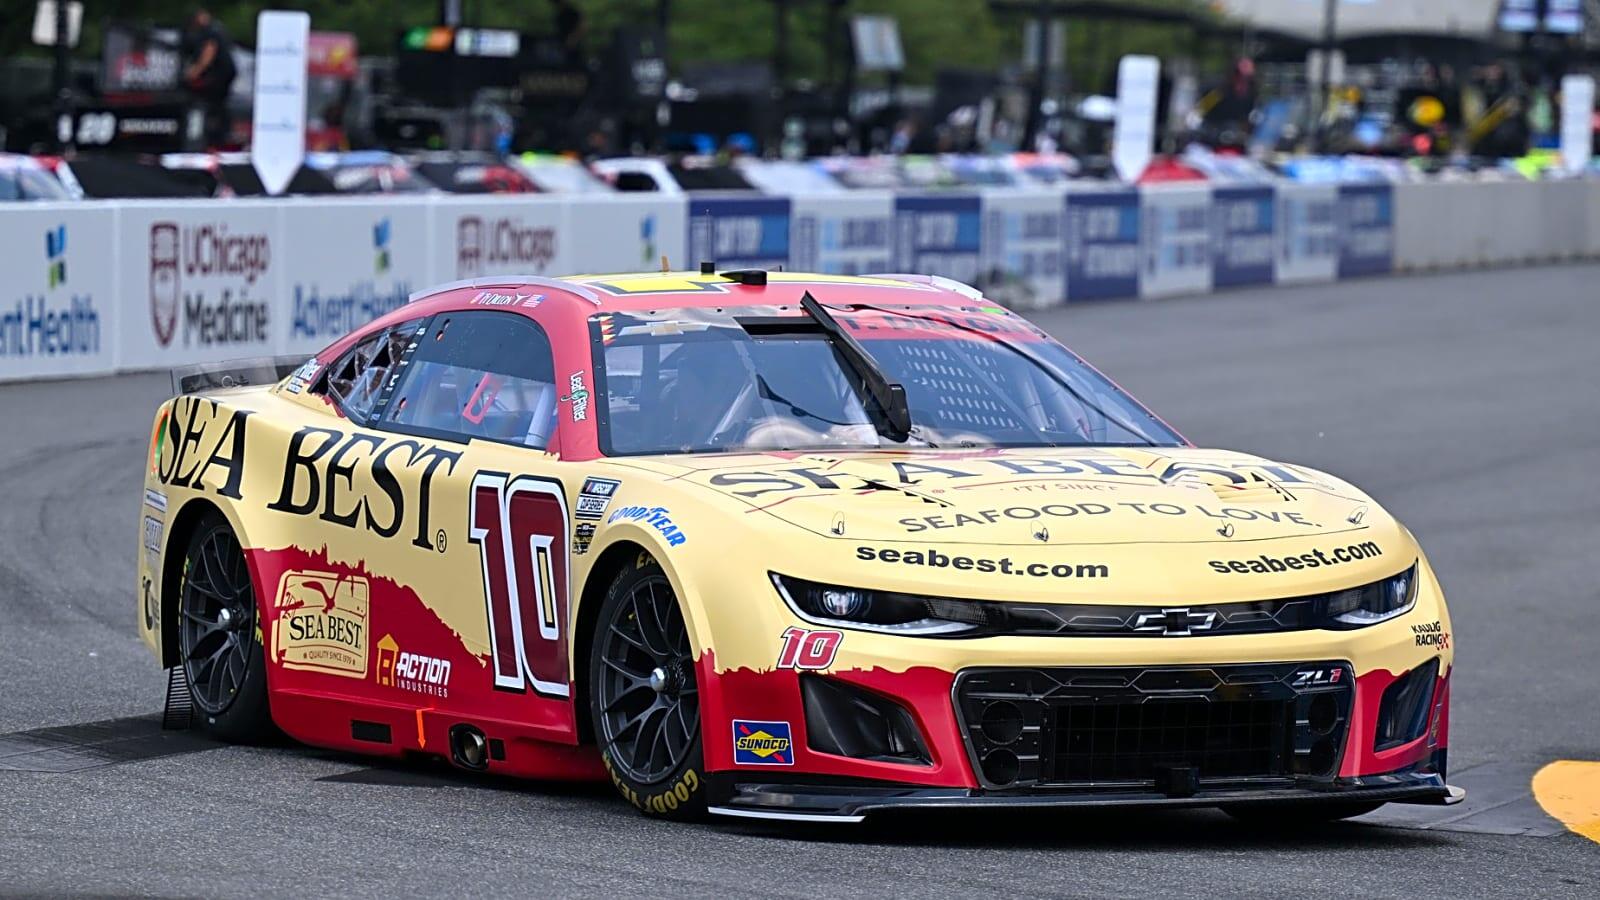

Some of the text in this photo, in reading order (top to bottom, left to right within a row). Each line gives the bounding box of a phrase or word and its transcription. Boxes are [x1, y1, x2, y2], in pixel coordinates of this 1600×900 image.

[184, 223, 271, 284] UChicago
[183, 290, 269, 347] Medicine
[158, 396, 247, 500] SEA
[898, 501, 1323, 533] SEAFOOD TO LOVE.
[856, 545, 1109, 578] seabest.com
[1208, 539, 1383, 574] seabest.com
[468, 469, 570, 698] 10
[289, 614, 326, 641] SEA
[1411, 621, 1441, 634] KAULIG
[1415, 634, 1443, 647] RACING
[776, 626, 844, 670] 10
[396, 652, 451, 686] ACTION
[1291, 667, 1343, 687] ZL1
[397, 679, 449, 698] INDUSTRIES
[737, 738, 788, 751] SUNOCO
